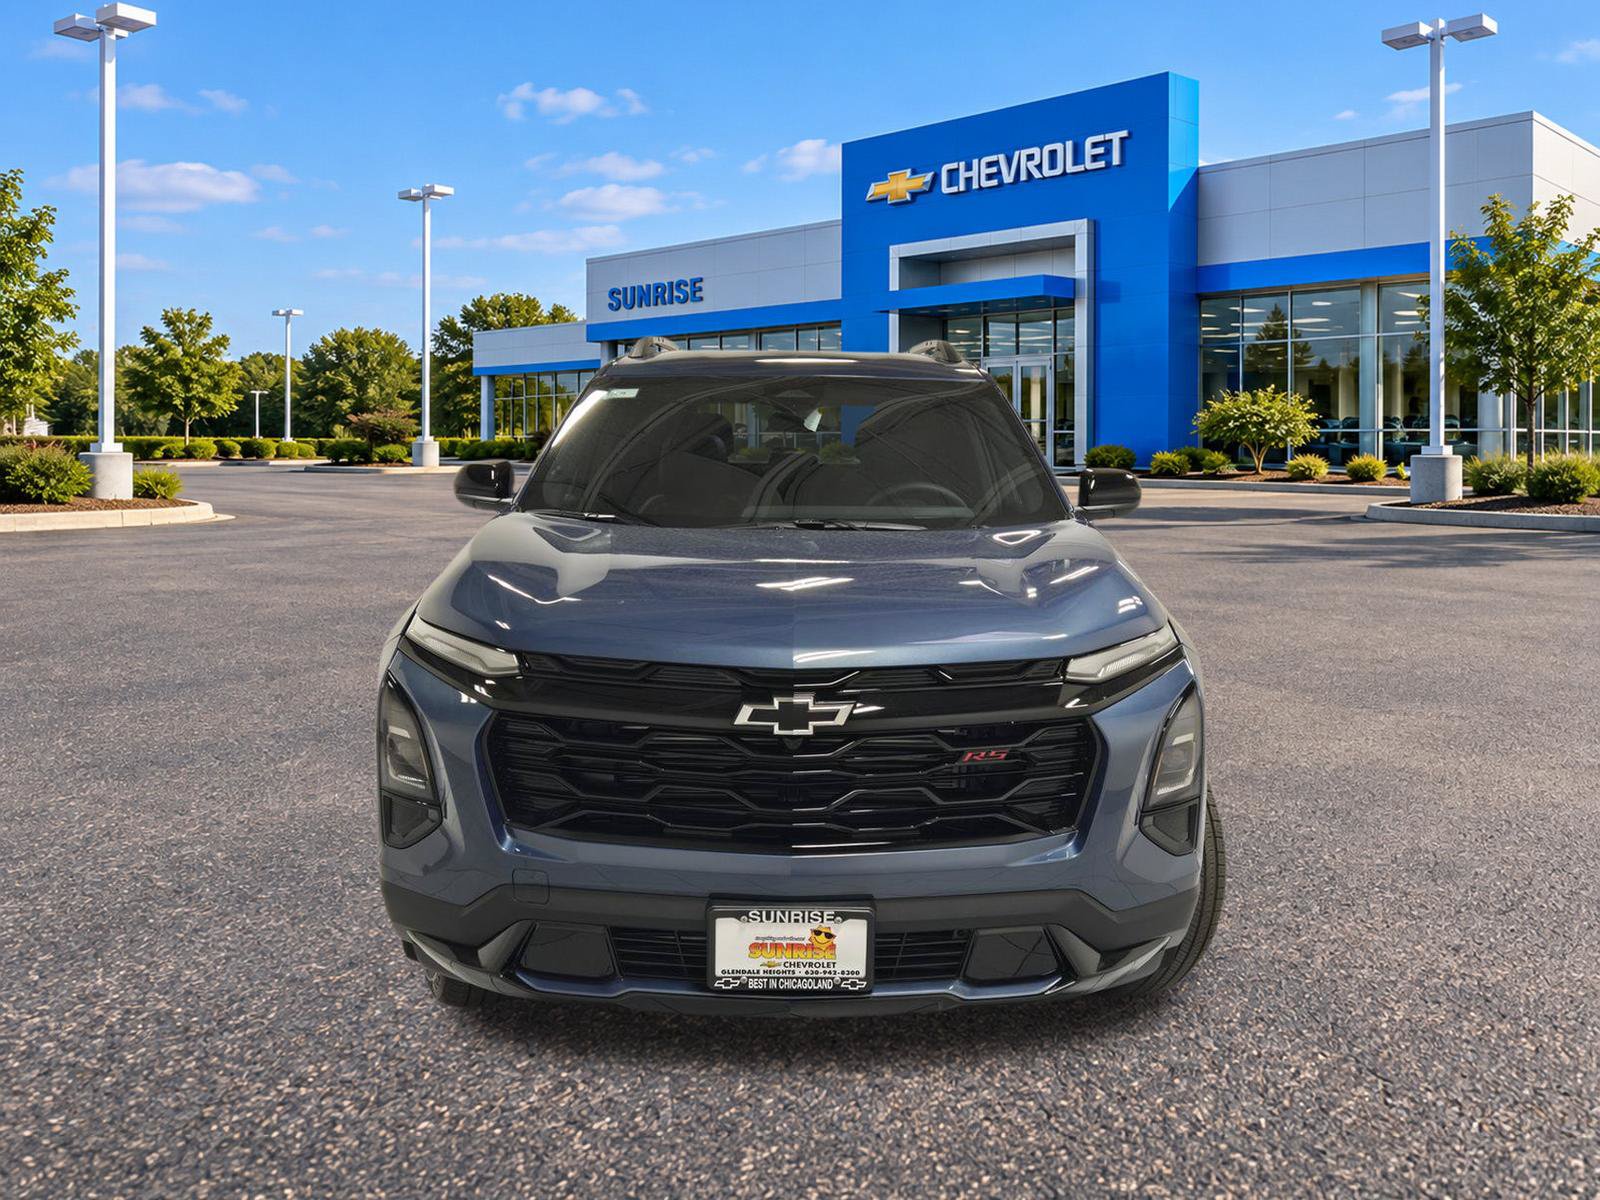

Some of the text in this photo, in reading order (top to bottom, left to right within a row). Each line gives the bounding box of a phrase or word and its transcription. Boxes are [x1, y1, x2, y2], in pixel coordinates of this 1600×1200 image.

[941, 129, 1129, 194] CHEVROLET
[608, 277, 704, 312] SUNRISE
[962, 749, 1008, 761] RS
[748, 910, 835, 923] SUNRISE
[748, 942, 837, 960] SUNRISE
[783, 961, 837, 969] CHEVROLET
[748, 978, 833, 990] BEST IN CHICAGOLAND
